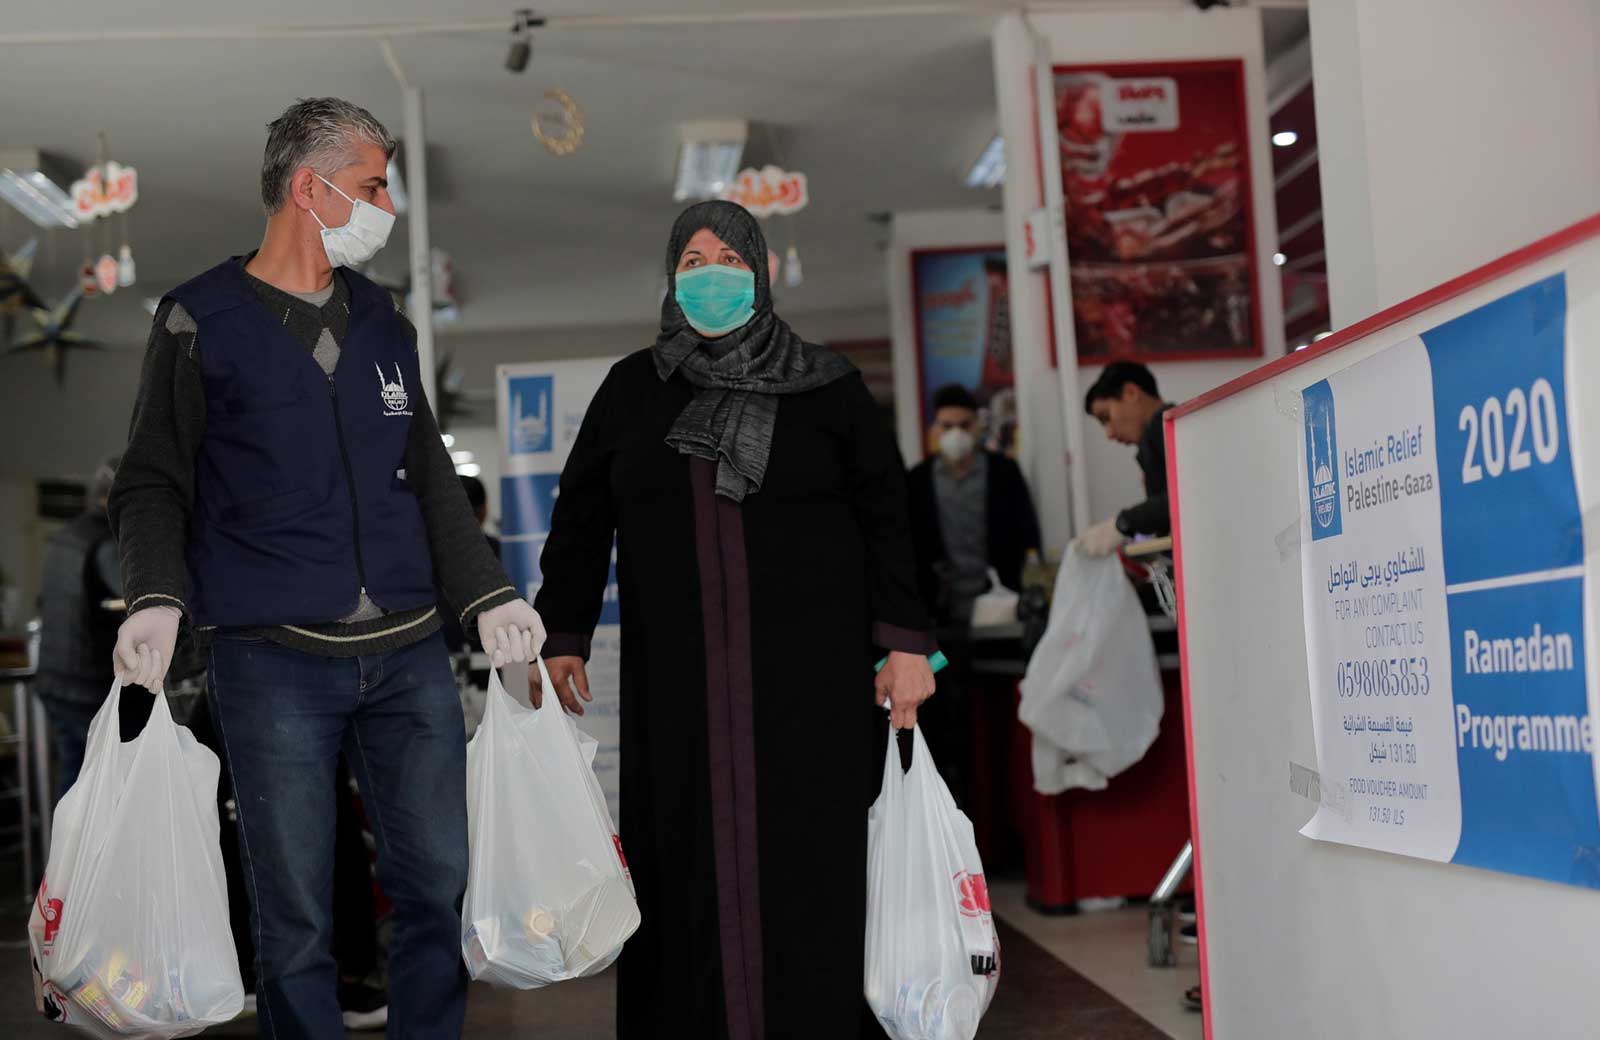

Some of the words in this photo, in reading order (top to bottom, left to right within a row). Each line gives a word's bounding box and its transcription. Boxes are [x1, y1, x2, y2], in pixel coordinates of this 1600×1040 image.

[1344, 441, 1385, 479] Islamic
[1387, 425, 1423, 465] Relief
[1458, 378, 1559, 485] 2020
[1346, 472, 1433, 513] Palestine-Gaza
[1328, 559, 1359, 594] التواصل
[1335, 599, 1351, 620] FOR
[1353, 597, 1370, 618] ANY
[1371, 588, 1424, 617] COMPLAINT
[1365, 622, 1407, 649] CONTACT
[1409, 621, 1425, 645] US
[1464, 622, 1574, 674] Ramadan
[1337, 656, 1431, 698] 0598085853
[1456, 703, 1593, 762] Programme
[1389, 743, 1417, 764] 131.50
[1349, 777, 1366, 794] FOOD
[1367, 778, 1397, 797] VOUCHER
[1398, 783, 1428, 801] AMOUNT
